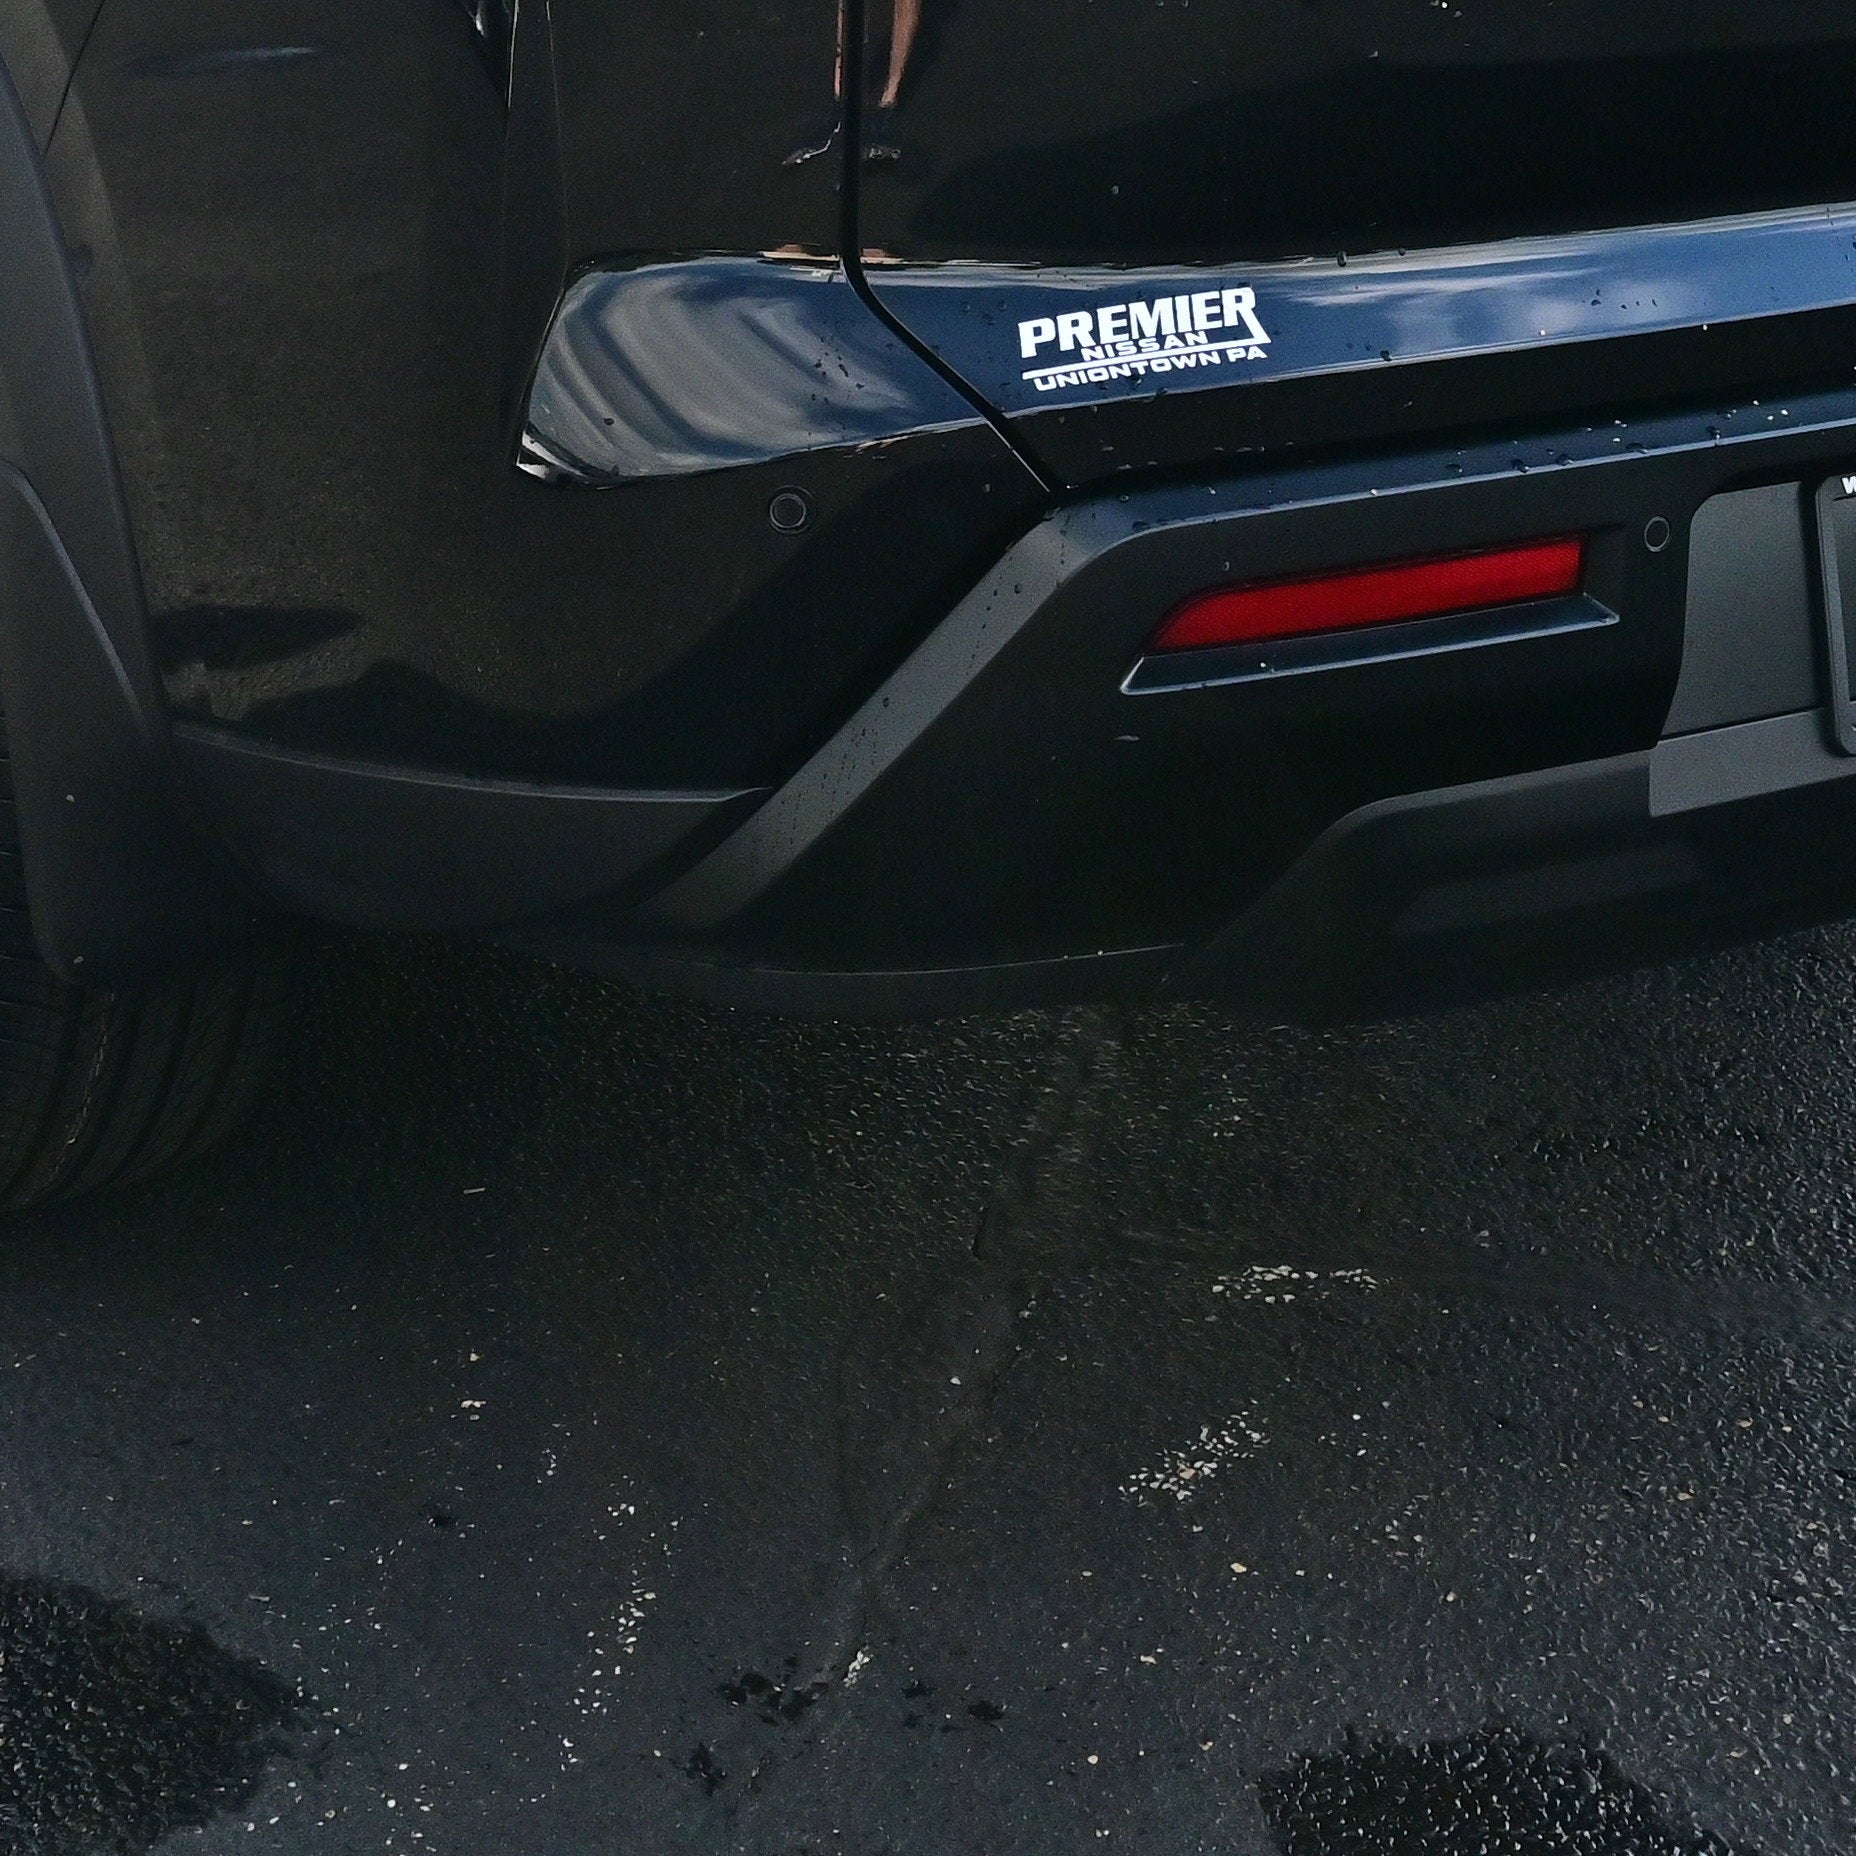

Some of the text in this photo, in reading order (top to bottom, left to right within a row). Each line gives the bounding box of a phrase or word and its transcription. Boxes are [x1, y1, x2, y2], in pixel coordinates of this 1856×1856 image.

[1018, 286, 1271, 359] PREMIER
[1080, 330, 1209, 362] NISSAN
[1033, 345, 1268, 392] UNIONTOWN PA
